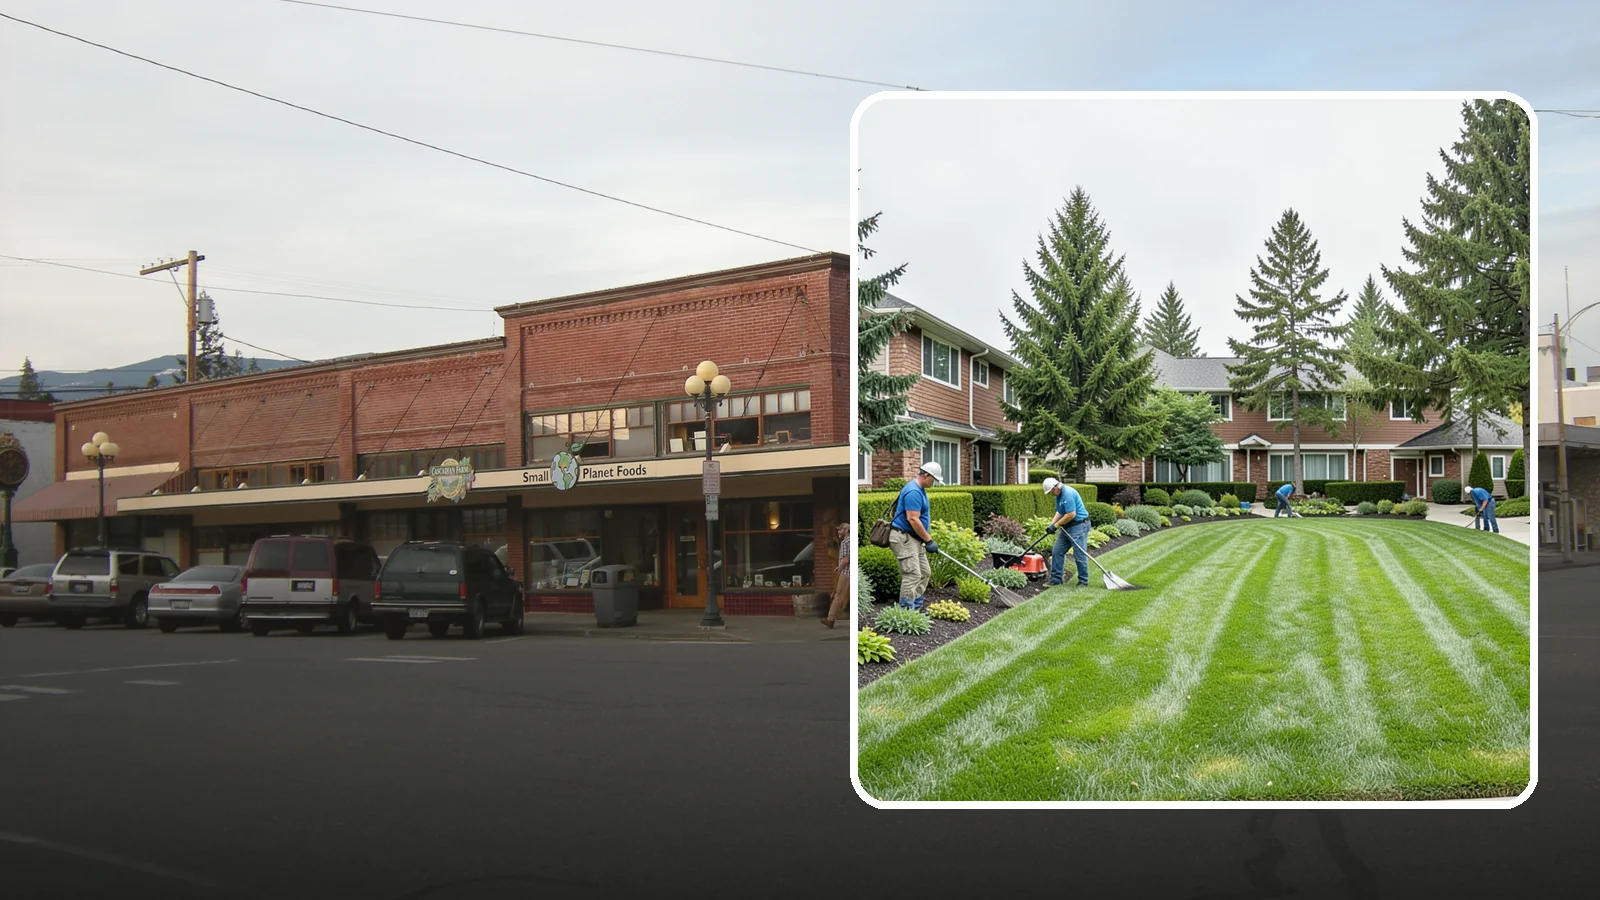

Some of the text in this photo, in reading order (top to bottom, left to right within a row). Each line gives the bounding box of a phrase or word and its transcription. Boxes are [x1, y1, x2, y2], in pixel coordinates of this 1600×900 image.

[523, 464, 647, 483] Small Planet Foods
